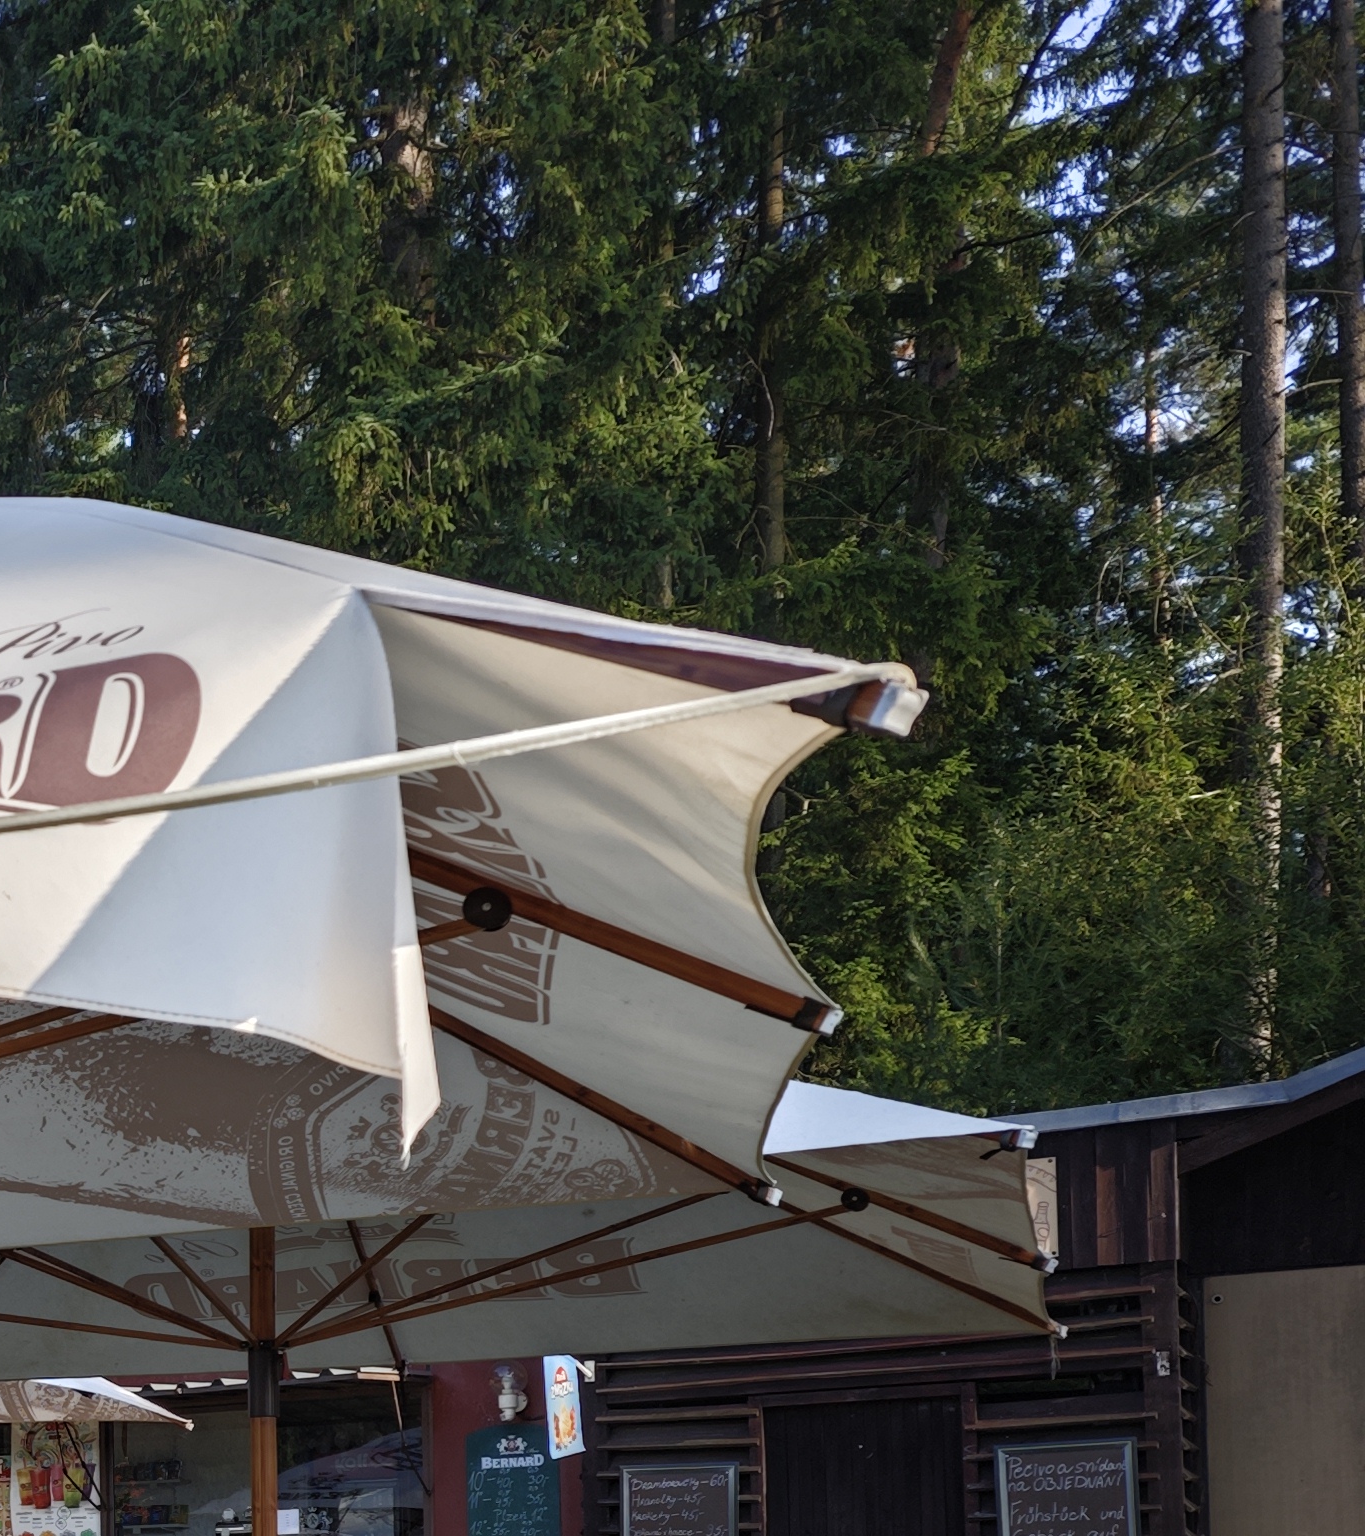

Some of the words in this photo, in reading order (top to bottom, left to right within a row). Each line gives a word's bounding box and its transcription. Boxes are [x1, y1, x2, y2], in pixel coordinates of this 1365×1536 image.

[480, 1453, 545, 1470] BERNARD
[1008, 1482, 1032, 1493] na
[1010, 1500, 1091, 1526] Frühstück
[1100, 1505, 1126, 1521] und
